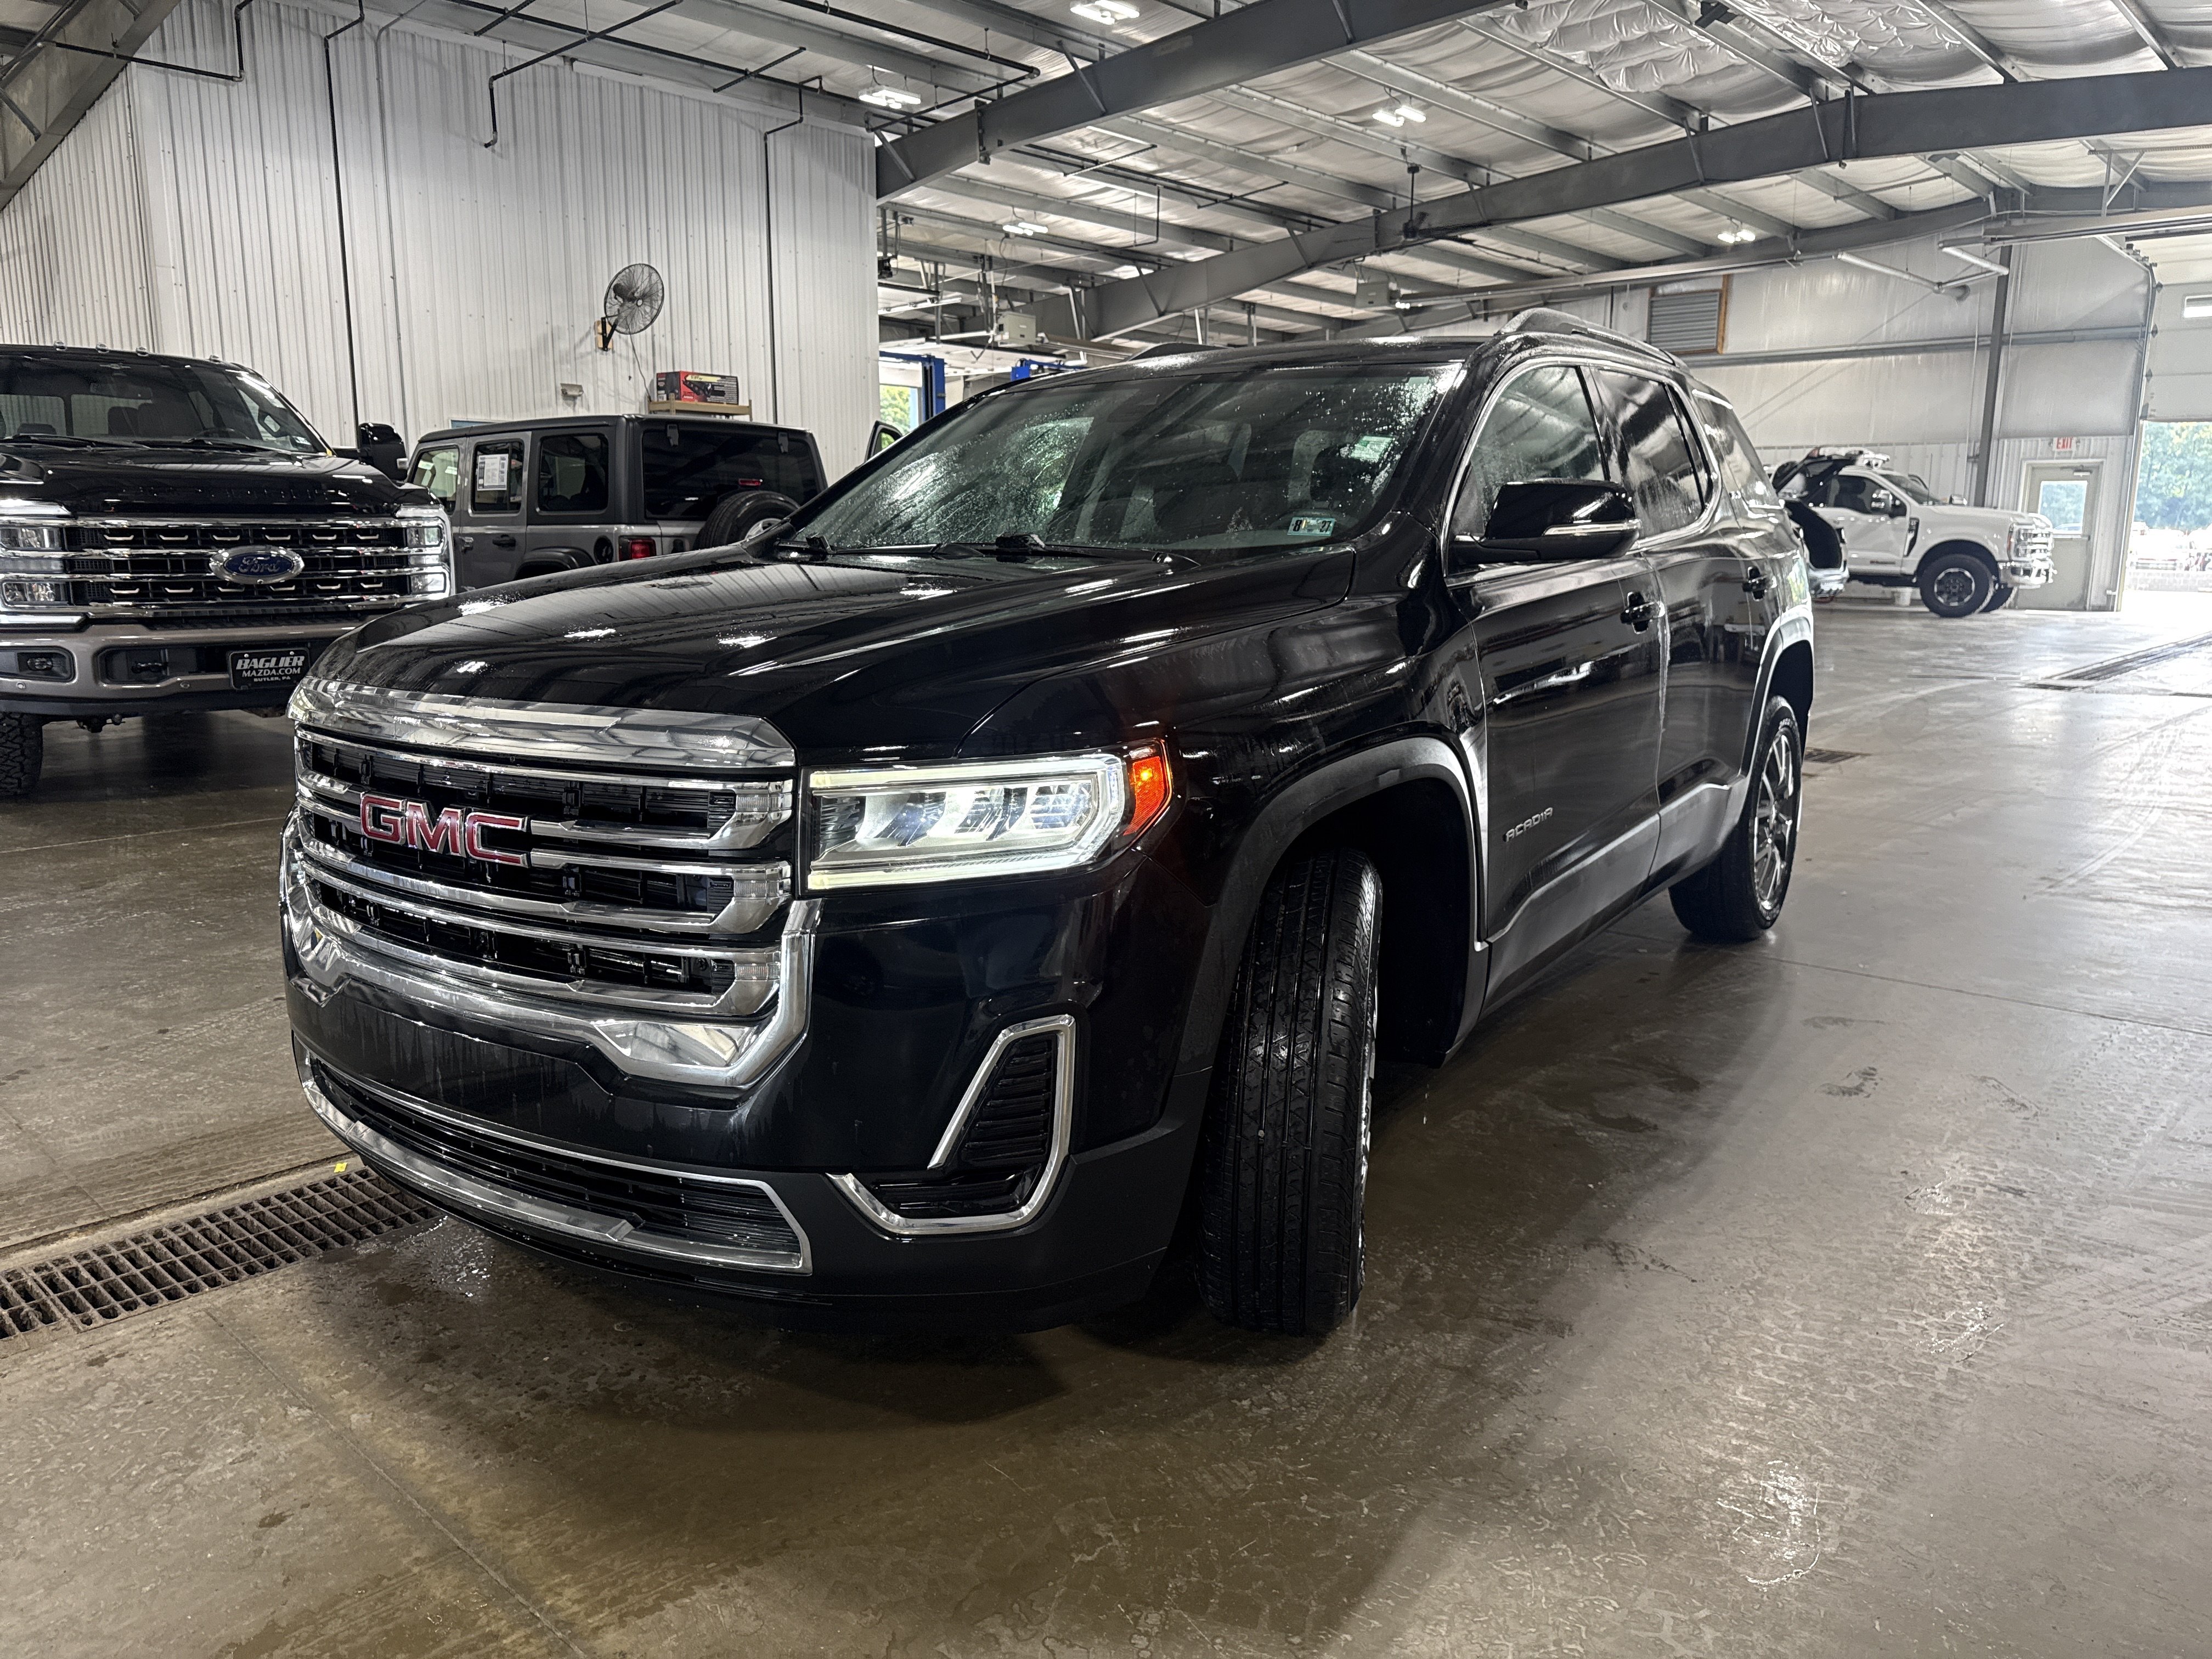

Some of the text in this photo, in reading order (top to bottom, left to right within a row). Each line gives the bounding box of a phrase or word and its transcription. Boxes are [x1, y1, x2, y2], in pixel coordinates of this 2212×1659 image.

[2056, 437, 2073, 449] EXIT
[1293, 520, 1331, 532] 8 27
[238, 556, 281, 573] Ford
[236, 655, 305, 670] BAGLIER
[242, 667, 301, 678] MAZDA.COM
[360, 794, 529, 869] GMC
[1505, 806, 1554, 843] ACADIA
